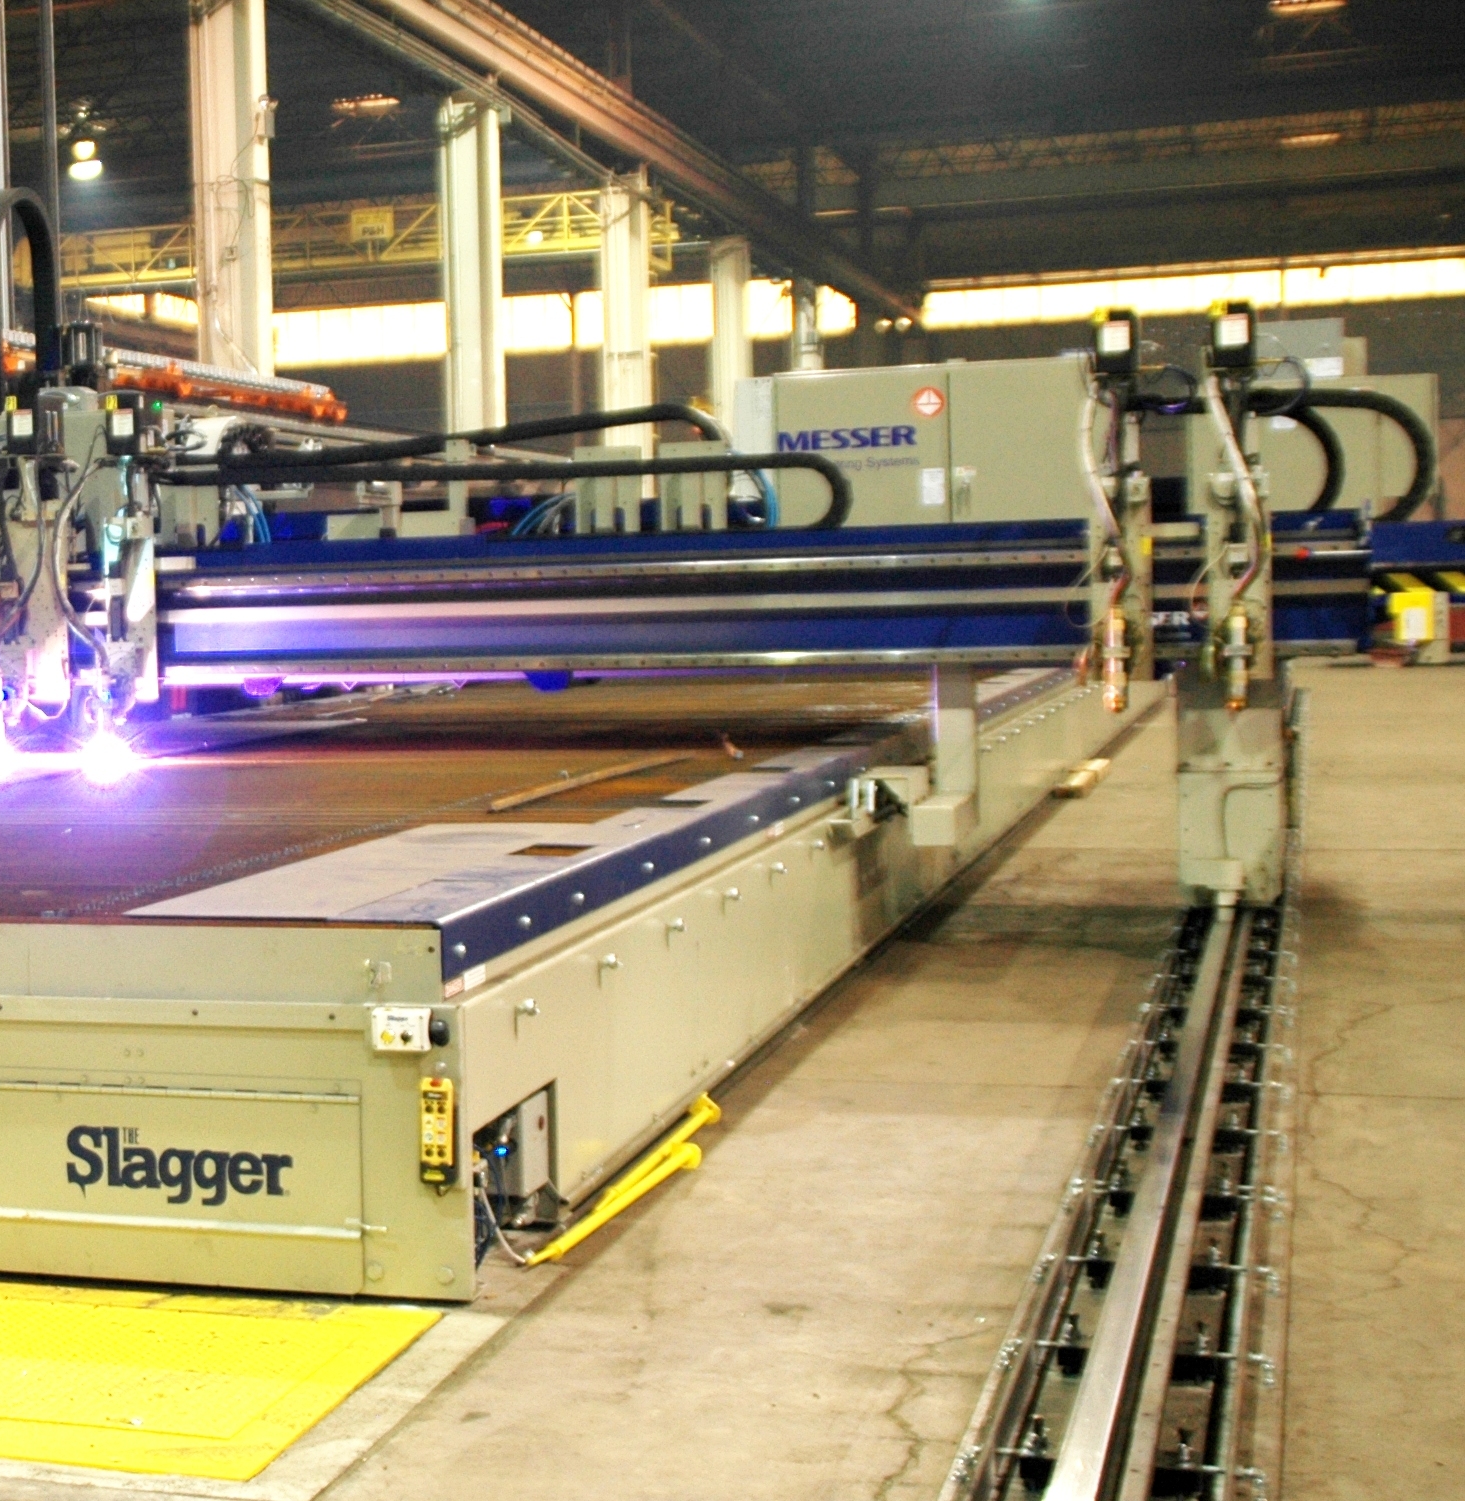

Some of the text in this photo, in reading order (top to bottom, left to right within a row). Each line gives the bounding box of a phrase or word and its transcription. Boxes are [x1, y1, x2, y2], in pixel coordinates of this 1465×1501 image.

[777, 425, 917, 452] MESSER
[866, 456, 919, 470] Systems
[123, 1127, 139, 1144] THE
[66, 1125, 293, 1206] Slagger
